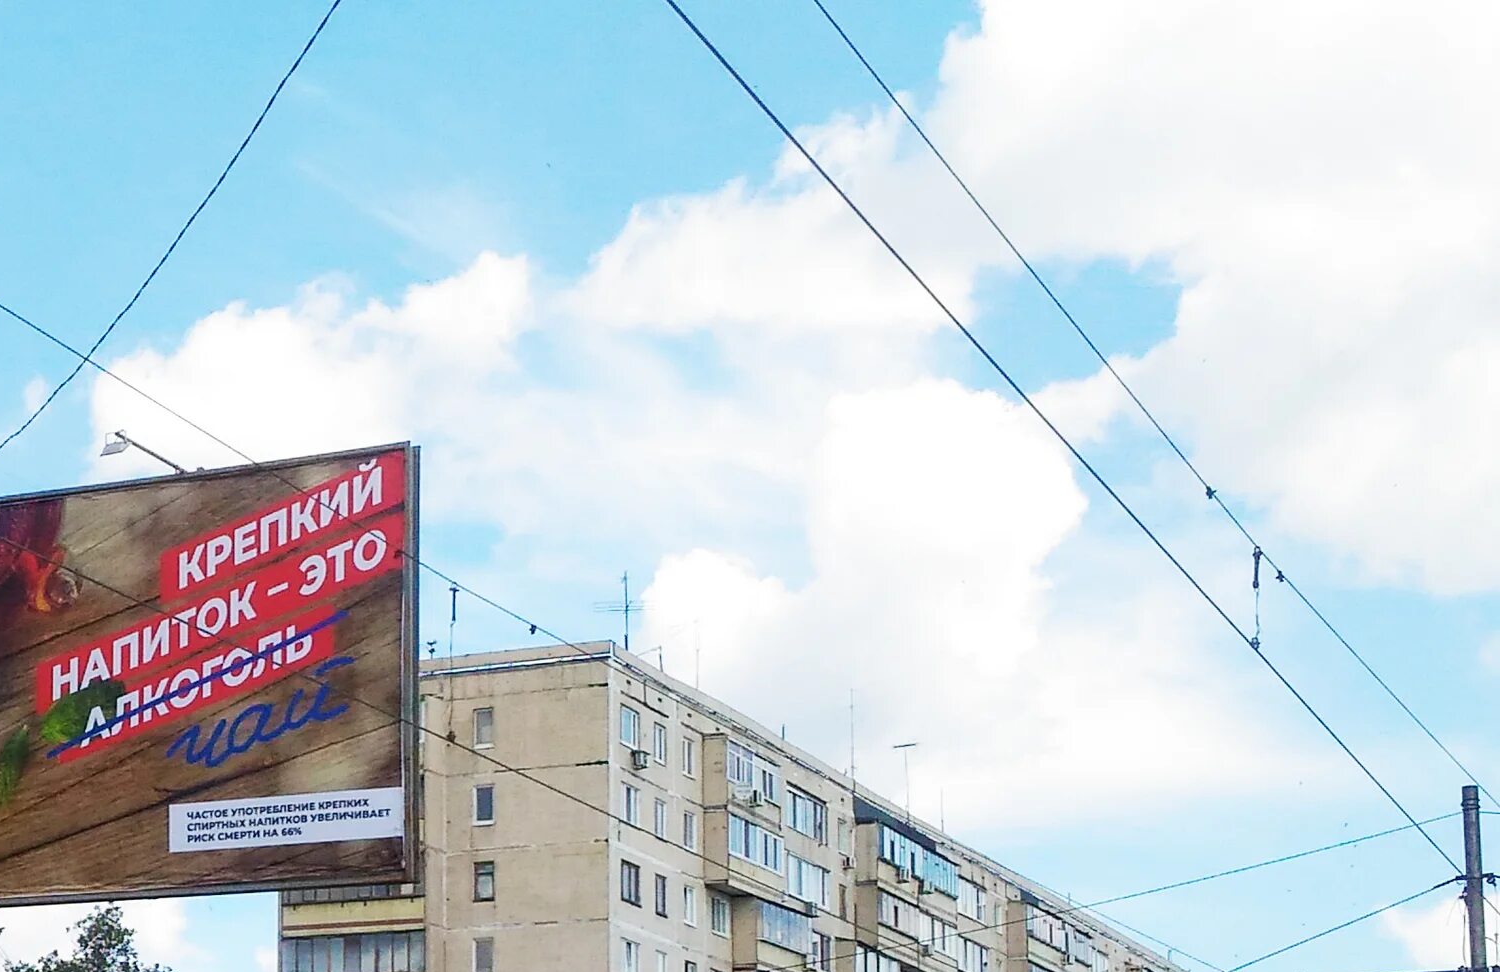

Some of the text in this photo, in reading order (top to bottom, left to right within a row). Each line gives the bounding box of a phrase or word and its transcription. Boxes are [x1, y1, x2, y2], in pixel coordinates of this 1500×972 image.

[178, 459, 383, 591] КРЕПКИЙ
[52, 581, 257, 701] НАПИТОК
[299, 529, 387, 597] ЭТО
[80, 624, 313, 748] АЛКОГОЛЬ
[166, 655, 357, 768] чай
[186, 799, 370, 820] ЧАСТОЕ УПОТРЕБЛЕНИЕ КРЕПКИХ
[187, 808, 392, 832] СПИРТНЫХ НАПИТКОВ УВЕЛИЧИВАЕТ
[187, 827, 303, 843] РИСК СМЕРТИ НА 66%
